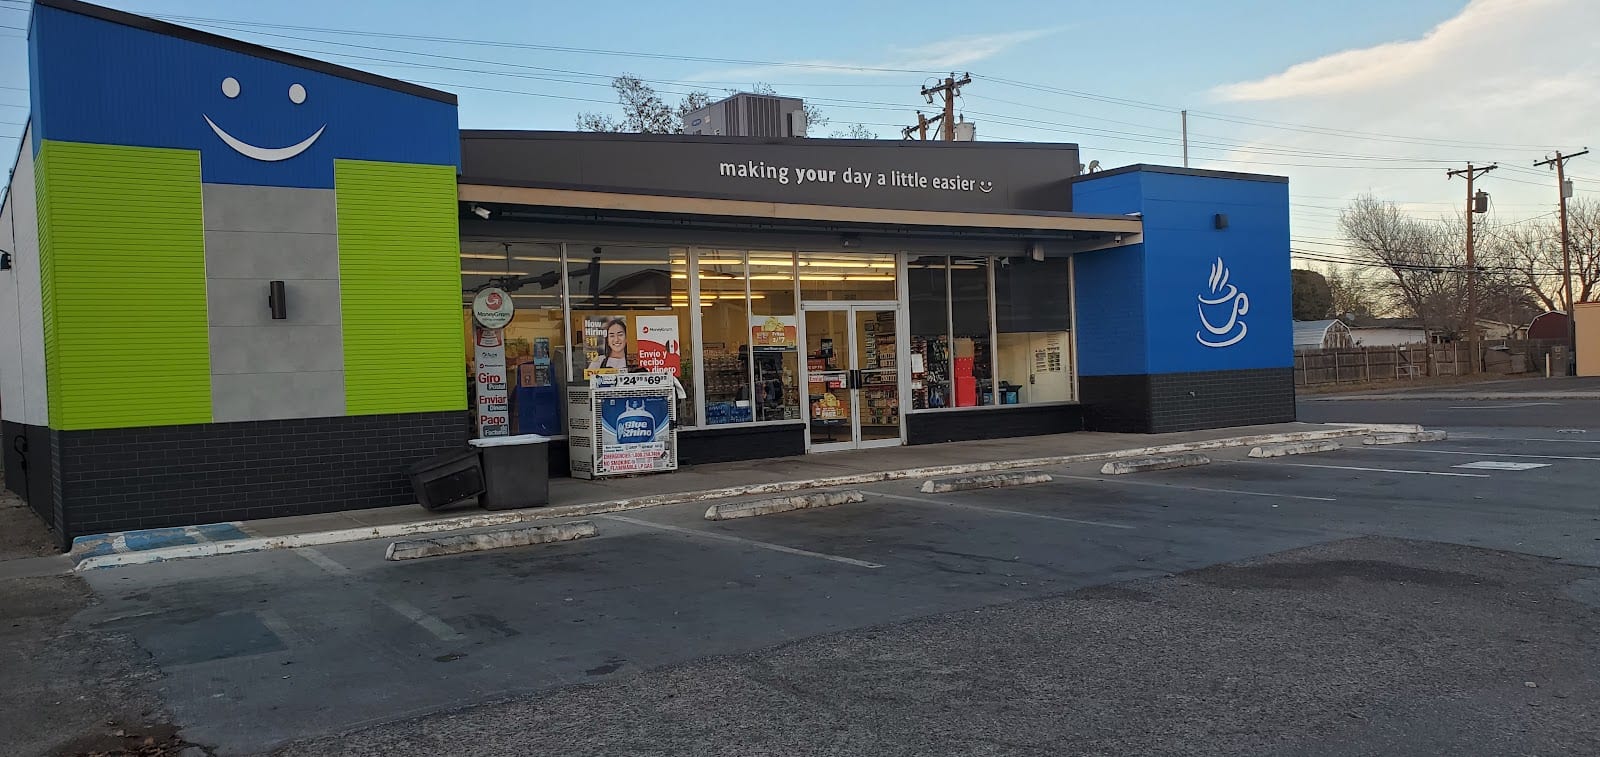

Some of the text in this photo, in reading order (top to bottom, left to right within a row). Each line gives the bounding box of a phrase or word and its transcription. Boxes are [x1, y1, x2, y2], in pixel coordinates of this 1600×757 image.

[719, 160, 976, 191] making your day a little easier
[584, 319, 602, 328] Now
[585, 328, 608, 337] Hiring
[661, 351, 667, 359] y
[639, 358, 664, 366] recibo
[478, 372, 501, 384] Giro
[479, 395, 507, 404] Enviar
[480, 415, 506, 426] Pago
[624, 420, 648, 428] Blue
[622, 429, 652, 438] Rhino
